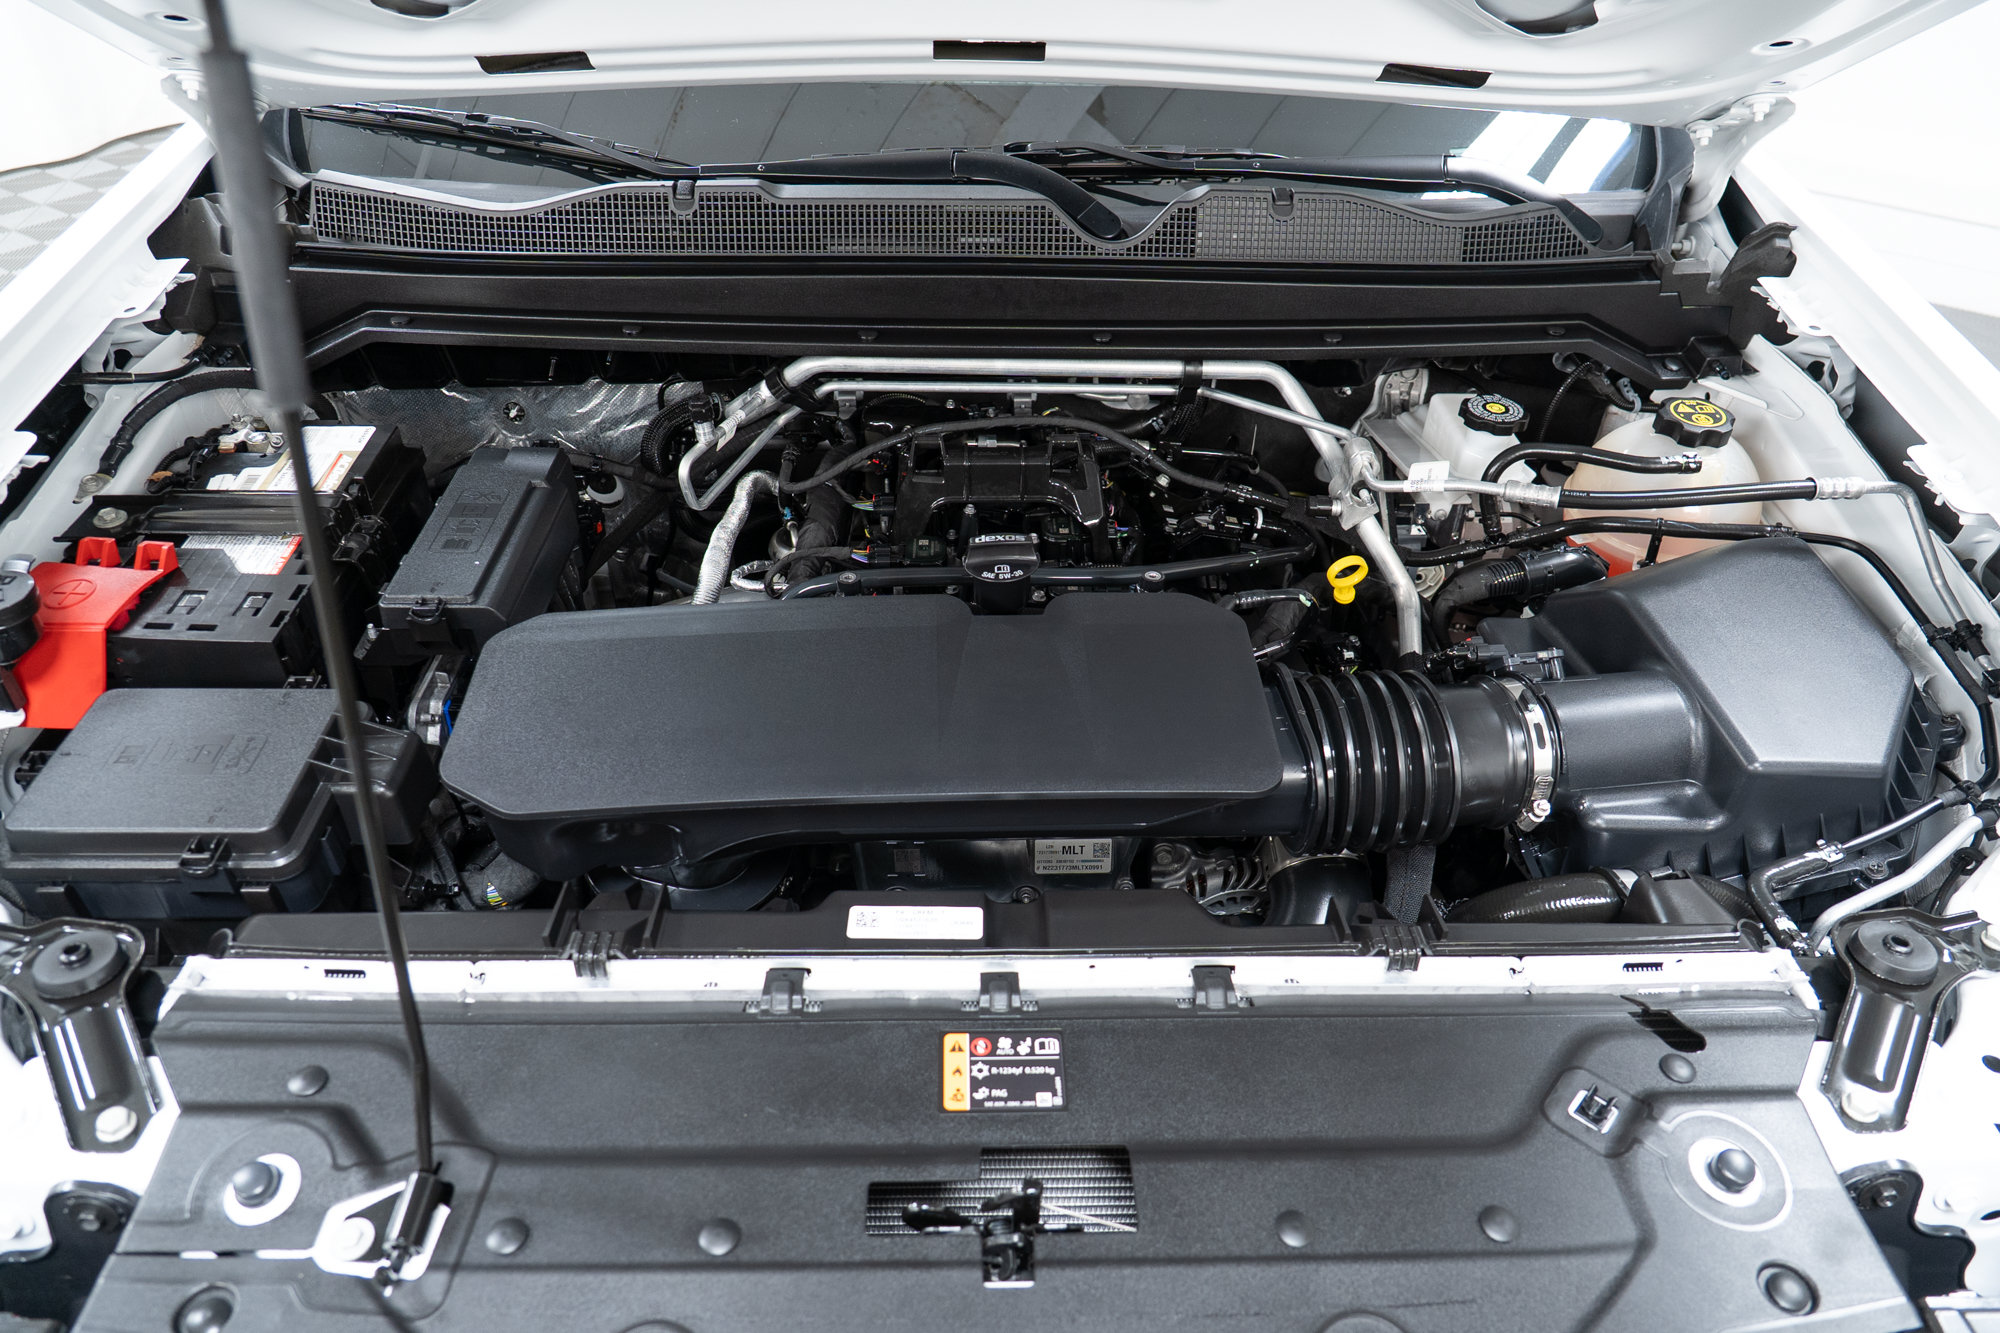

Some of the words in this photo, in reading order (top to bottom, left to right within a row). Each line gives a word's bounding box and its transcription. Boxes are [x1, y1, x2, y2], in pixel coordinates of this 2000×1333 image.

[974, 534, 1026, 544] dexos
[981, 571, 997, 579] SAE
[998, 569, 1024, 580] 5W-30
[1062, 845, 1085, 855] MLT
[1045, 1066, 1055, 1075] kg
[991, 1088, 1008, 1097] PAG
